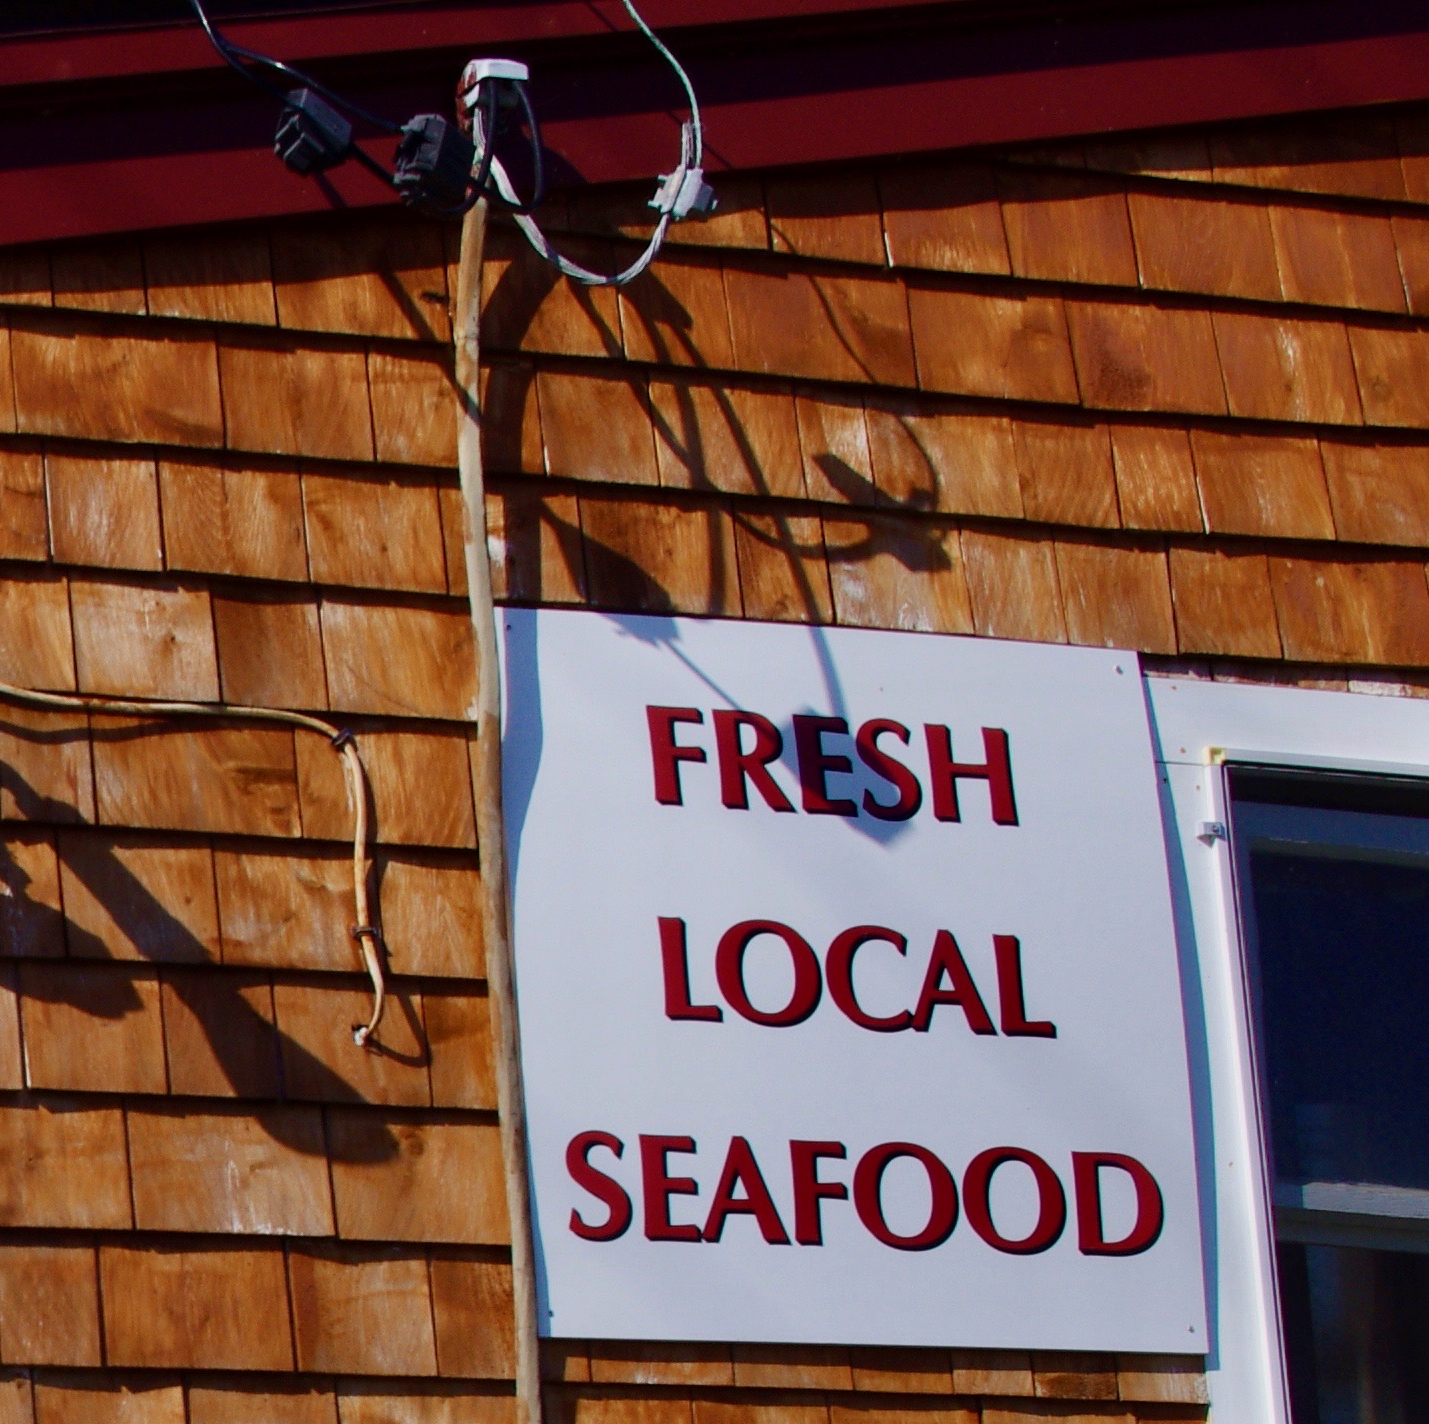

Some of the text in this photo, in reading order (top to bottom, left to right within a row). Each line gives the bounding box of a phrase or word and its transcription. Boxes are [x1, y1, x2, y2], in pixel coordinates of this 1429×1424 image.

[645, 704, 1019, 827] FRESH
[657, 916, 1057, 1039] LOCAL
[565, 1130, 1164, 1257] SEAFOOD
